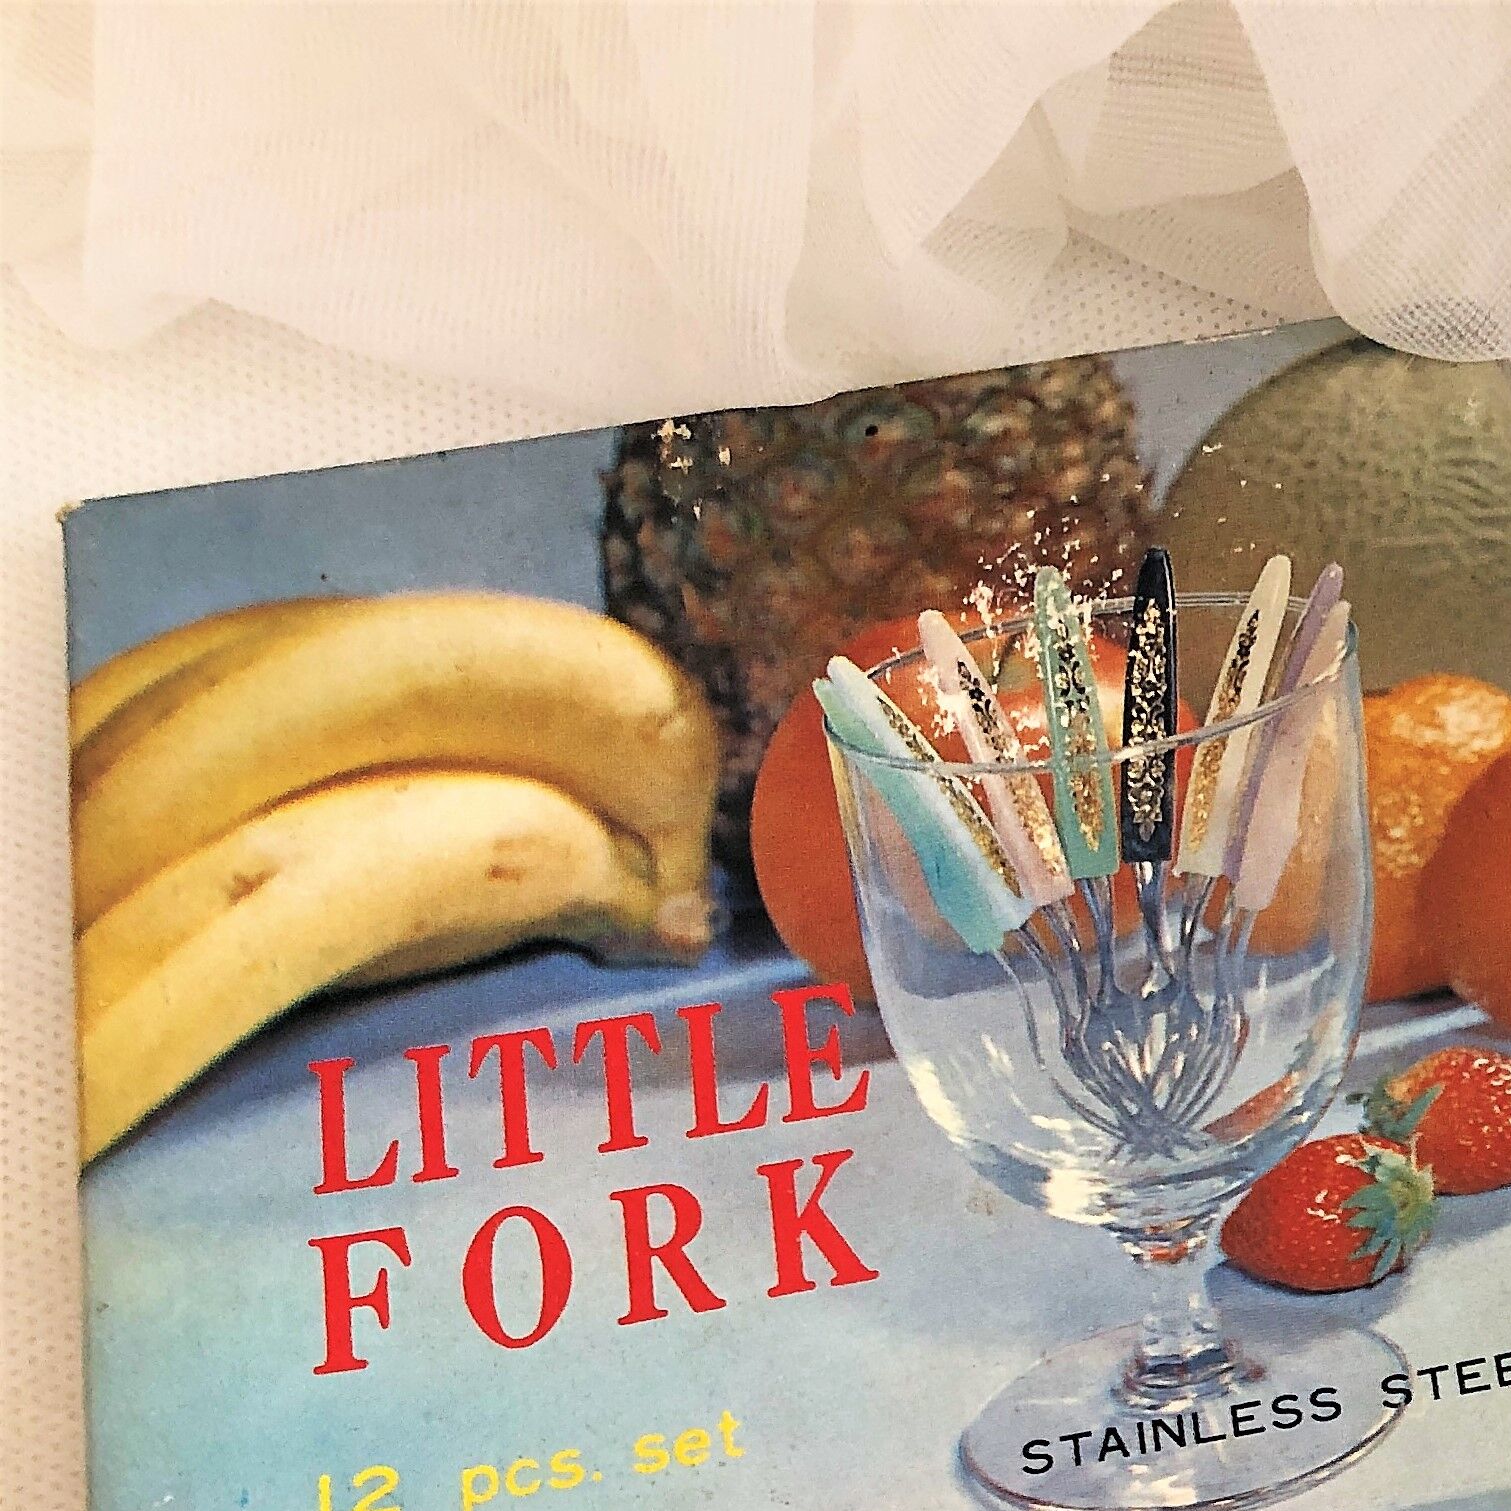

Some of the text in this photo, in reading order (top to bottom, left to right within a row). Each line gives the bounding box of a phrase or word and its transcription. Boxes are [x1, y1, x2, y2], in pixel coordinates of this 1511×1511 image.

[307, 981, 872, 1195] LITTLE
[307, 1148, 879, 1376] FORK
[632, 1409, 747, 1475] set
[1020, 1386, 1343, 1475] STAINLESS
